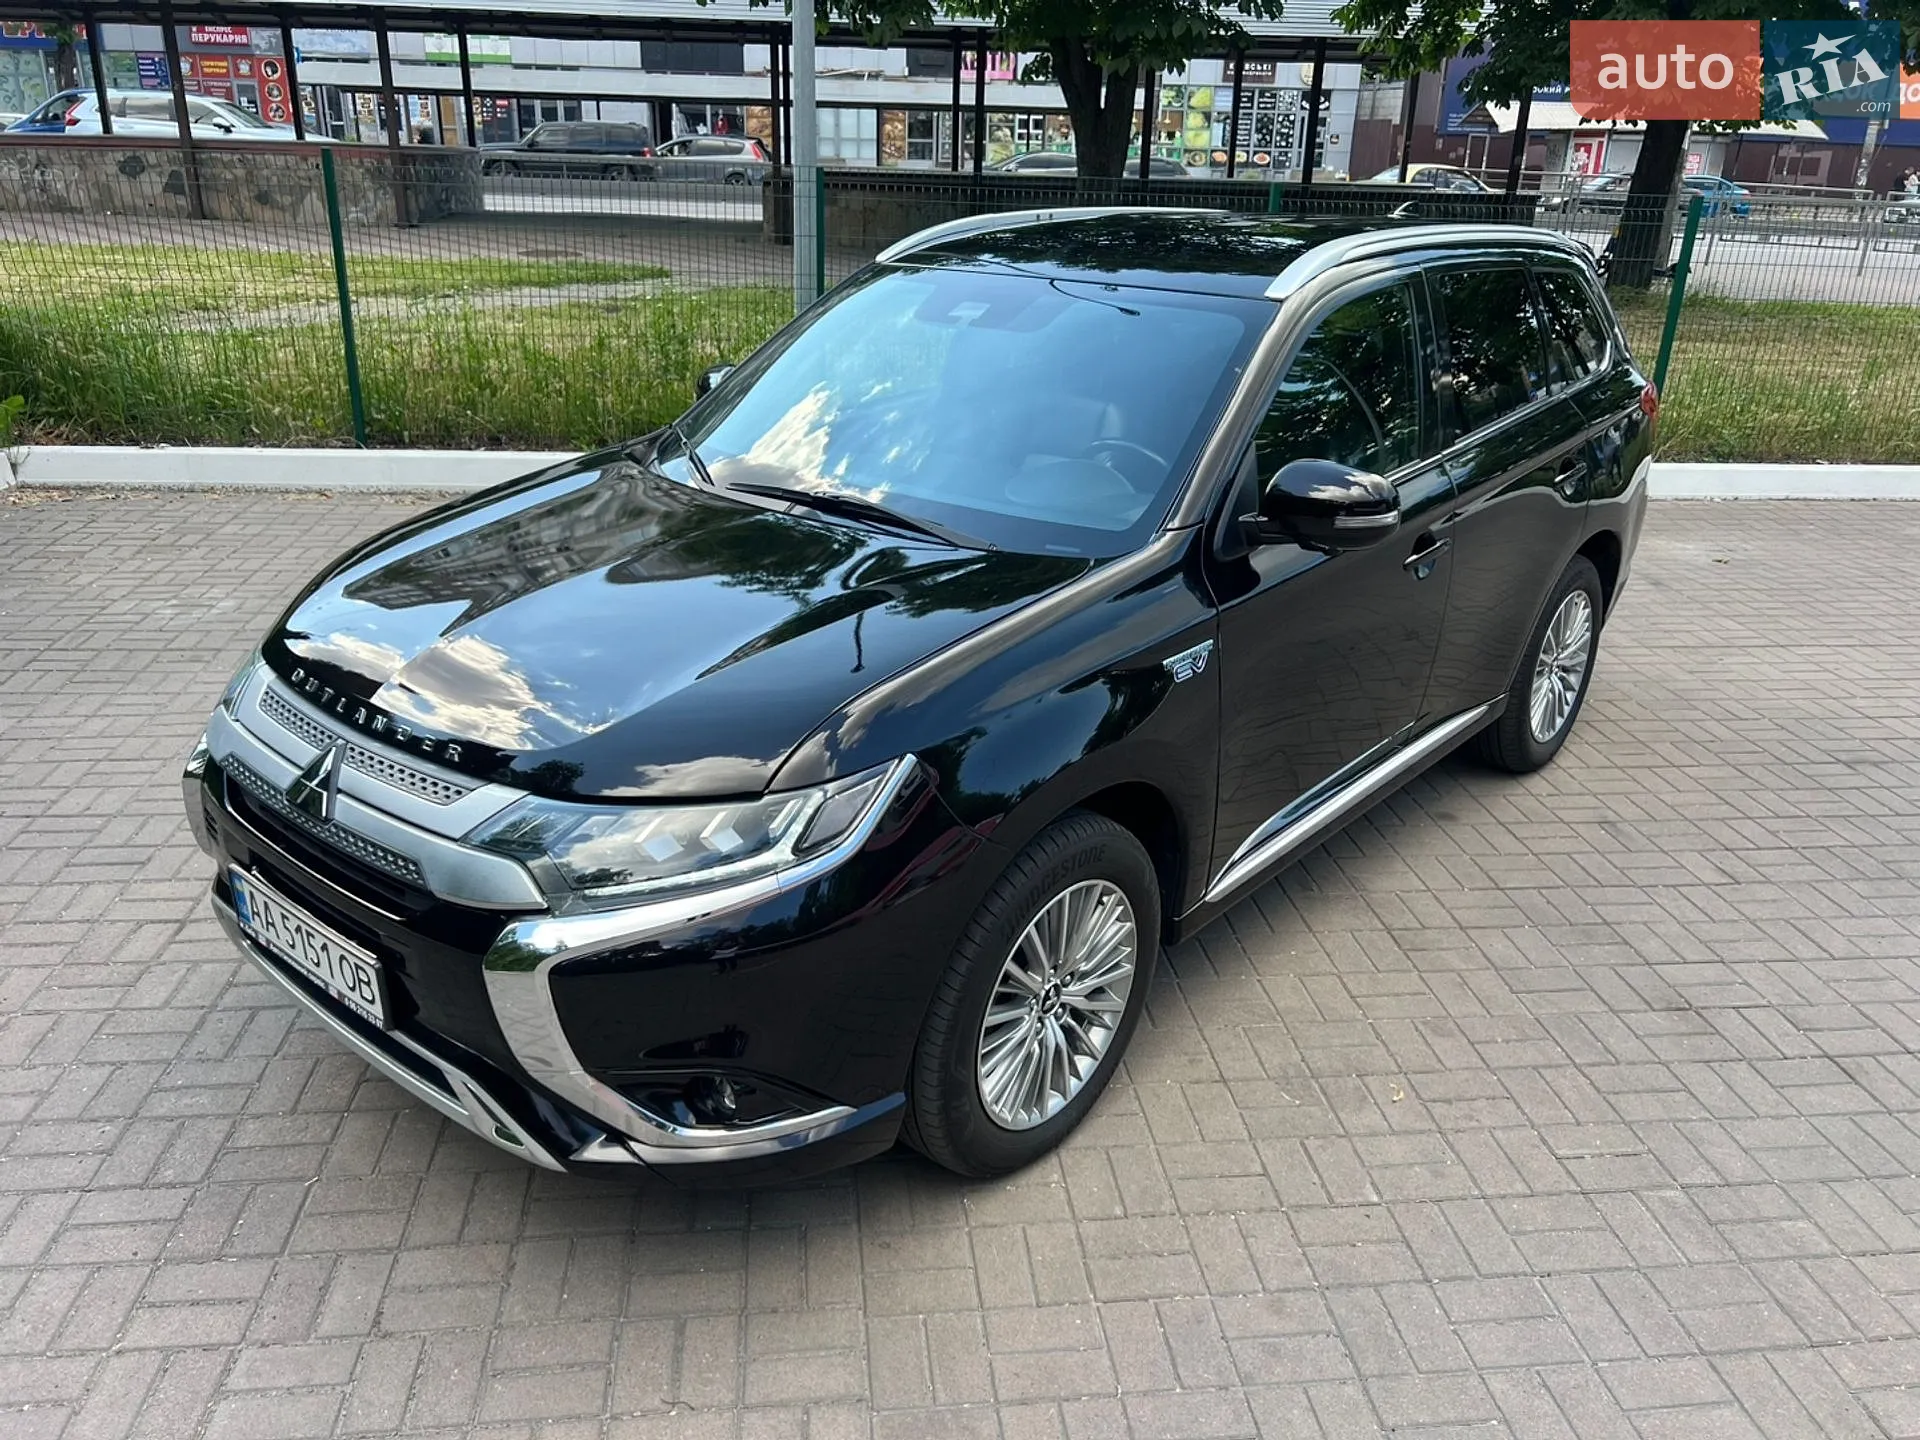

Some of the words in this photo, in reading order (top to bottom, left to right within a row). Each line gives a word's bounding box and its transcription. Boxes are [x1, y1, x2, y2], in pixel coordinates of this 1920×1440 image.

[1174, 651, 1208, 682] EV
[291, 667, 462, 762] OUTLANDER
[249, 889, 280, 940] AA
[280, 911, 334, 980] 5151
[339, 953, 376, 1005] OB
